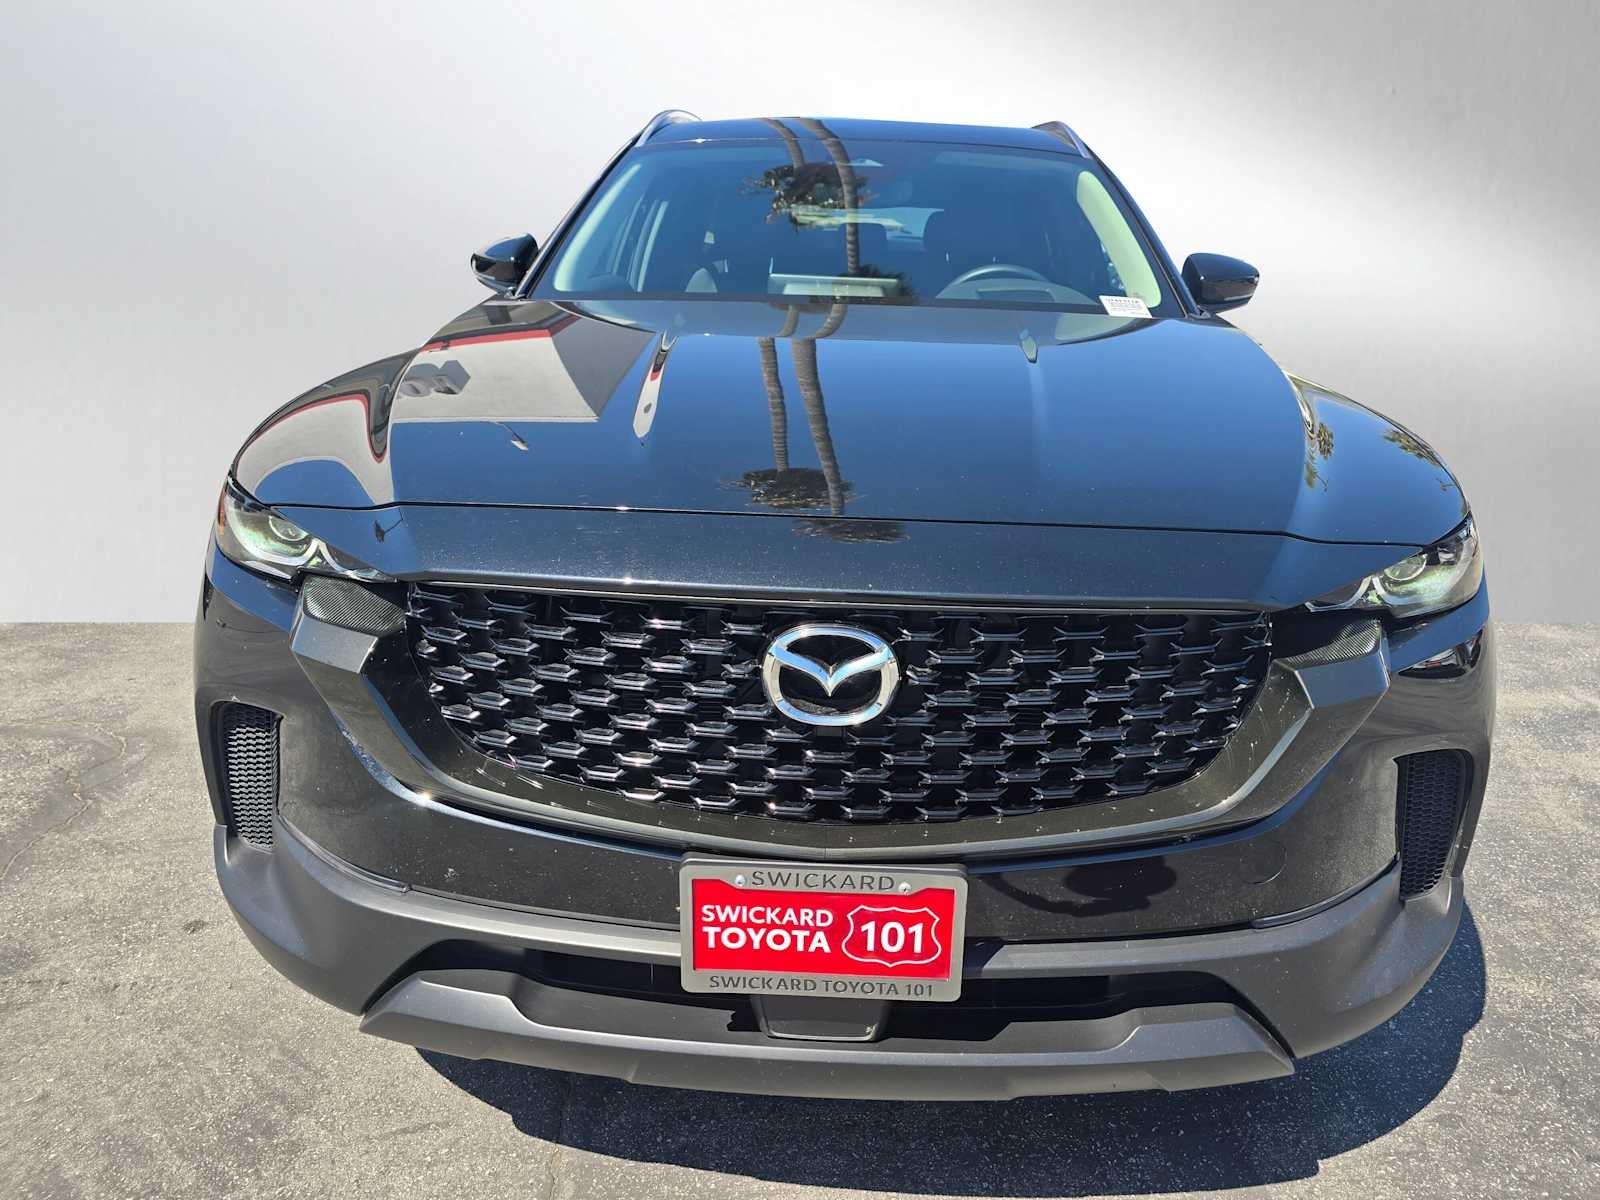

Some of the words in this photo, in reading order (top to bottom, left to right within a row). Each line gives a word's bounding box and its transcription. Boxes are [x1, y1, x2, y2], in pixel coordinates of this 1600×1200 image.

[751, 870, 895, 891] SWICKARD
[701, 904, 833, 927] SWICKARD
[702, 926, 831, 953] TOYOTA
[860, 921, 924, 953] 101
[709, 975, 817, 992] SWICKARD
[823, 980, 899, 996] TOYOTA
[904, 983, 933, 997] 101
